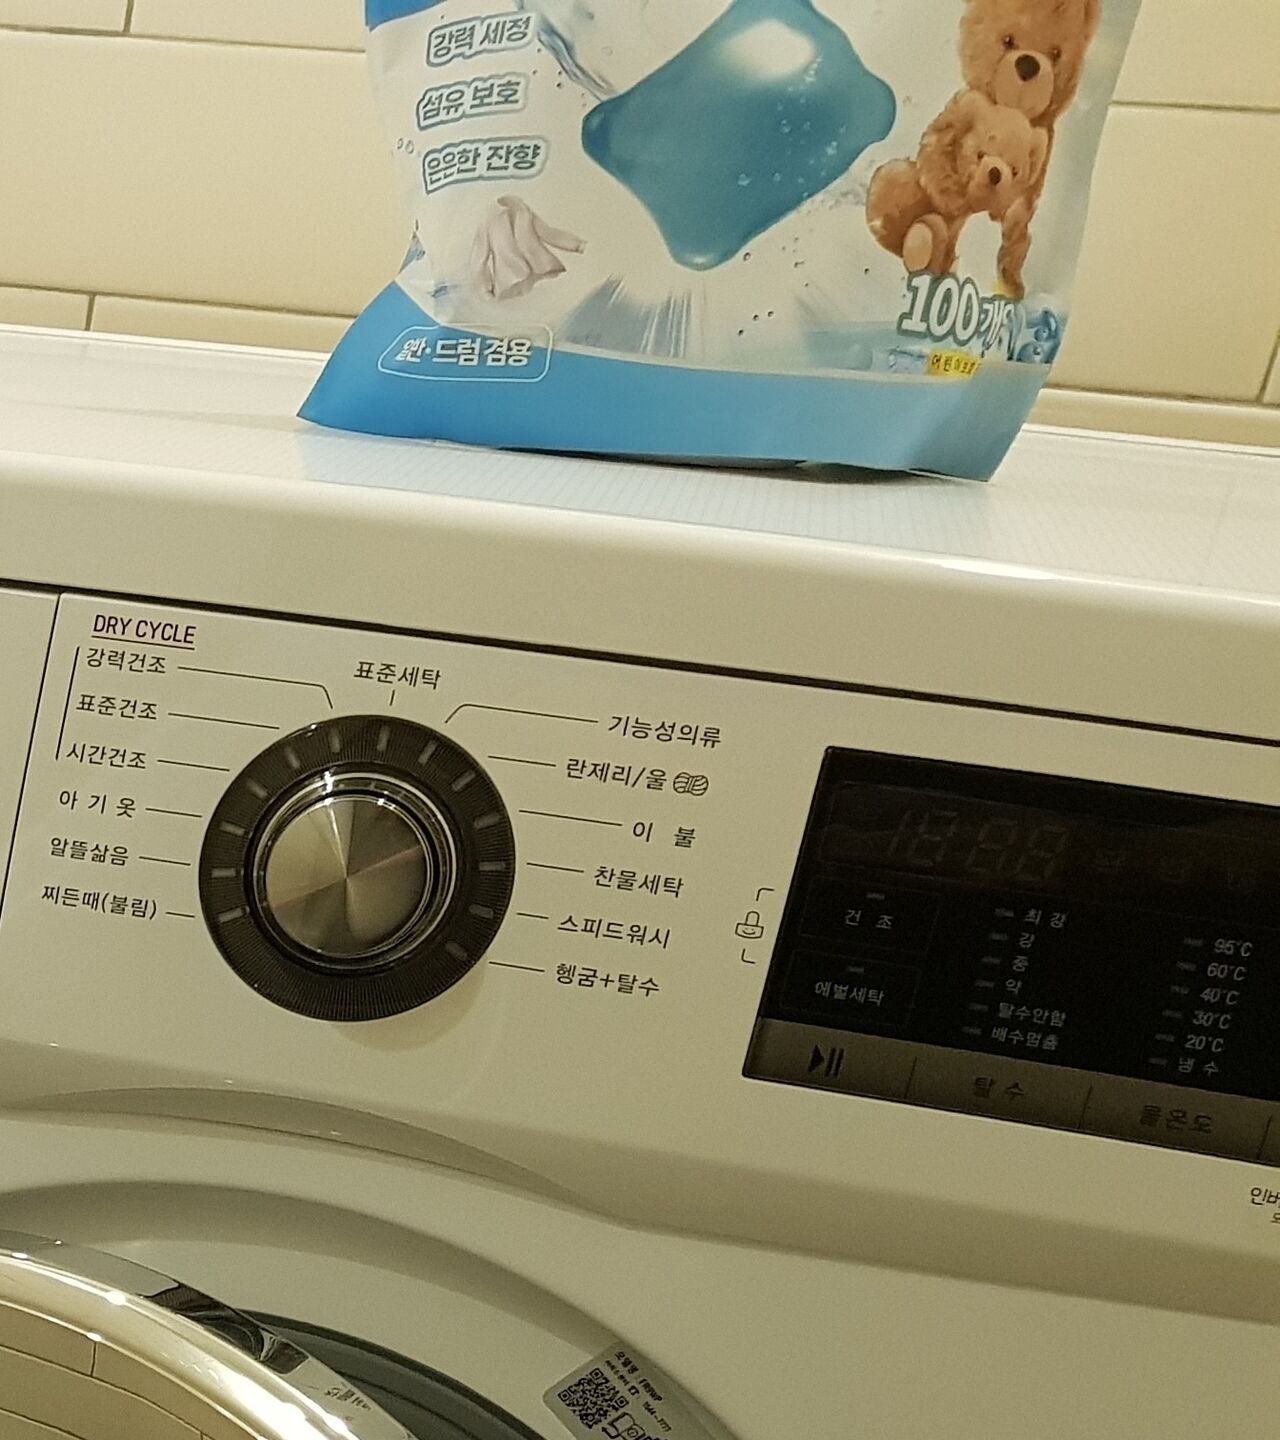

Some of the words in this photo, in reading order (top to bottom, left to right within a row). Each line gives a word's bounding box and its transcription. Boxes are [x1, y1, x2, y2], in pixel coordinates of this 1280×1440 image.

[433, 24, 476, 58] 강력
[480, 16, 531, 45] 세정
[422, 89, 465, 121] 섬유
[470, 80, 520, 110] 보호
[427, 147, 481, 185] 은은한
[486, 143, 542, 172] 잔향
[483, 337, 532, 367] 겸용
[93, 614, 132, 636] DRY
[135, 620, 197, 644] CYCLE
[85, 647, 167, 674] 강력건조
[354, 660, 442, 690] 표준세탁
[76, 693, 158, 720] 표준건조
[607, 715, 722, 749] 기능성의류
[66, 742, 147, 770] 시간건조
[565, 758, 667, 791] 란제리/울
[50, 837, 129, 866] 알뜰삶음
[593, 865, 685, 898] 찬물세탁
[41, 885, 157, 920] 찌든때(불림)
[557, 915, 672, 950] 스피드워시
[555, 963, 661, 997] 헹굼+탈수
[1140, 1105, 1213, 1135] 물온도
